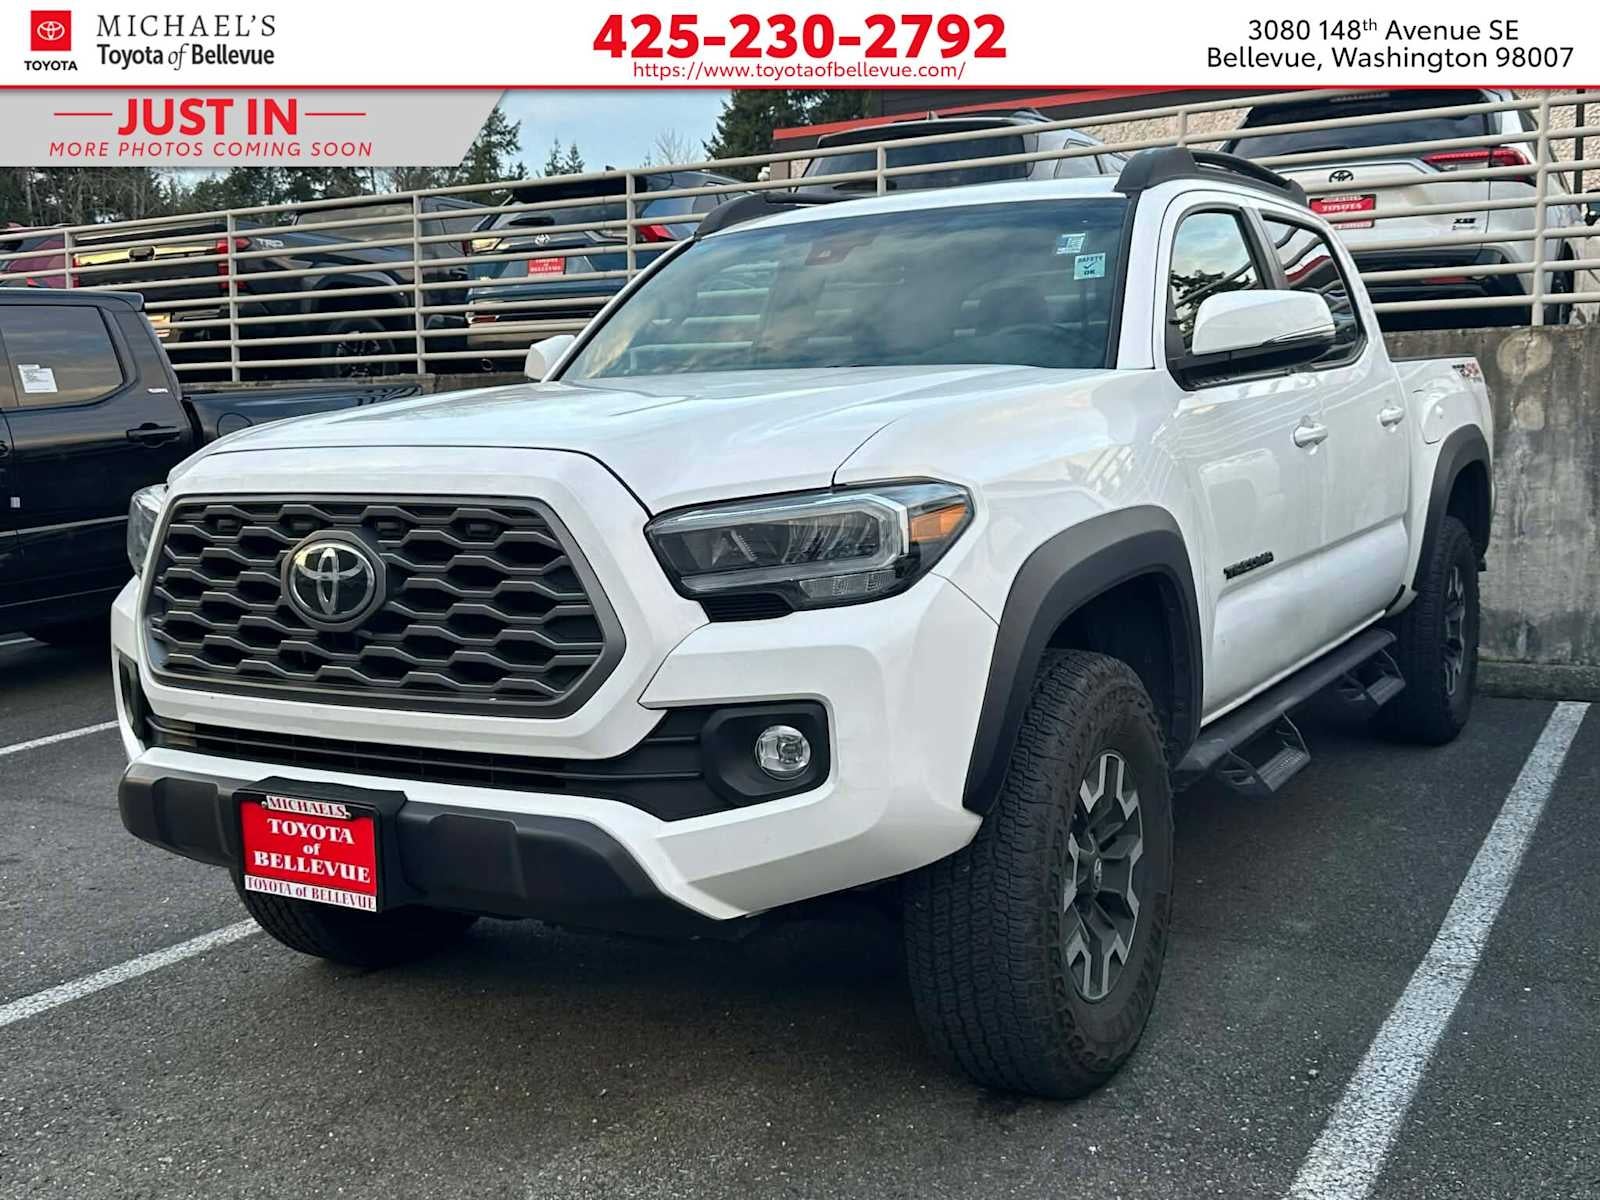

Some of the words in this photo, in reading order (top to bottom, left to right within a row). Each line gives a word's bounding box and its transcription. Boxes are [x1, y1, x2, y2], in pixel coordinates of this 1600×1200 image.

[266, 818, 355, 845] TOYOTA
[302, 843, 321, 856] of
[253, 850, 371, 884] BELLEVUE
[248, 876, 292, 896] TOYOTA
[295, 885, 308, 898] of
[311, 888, 376, 911] BELLEVUE
